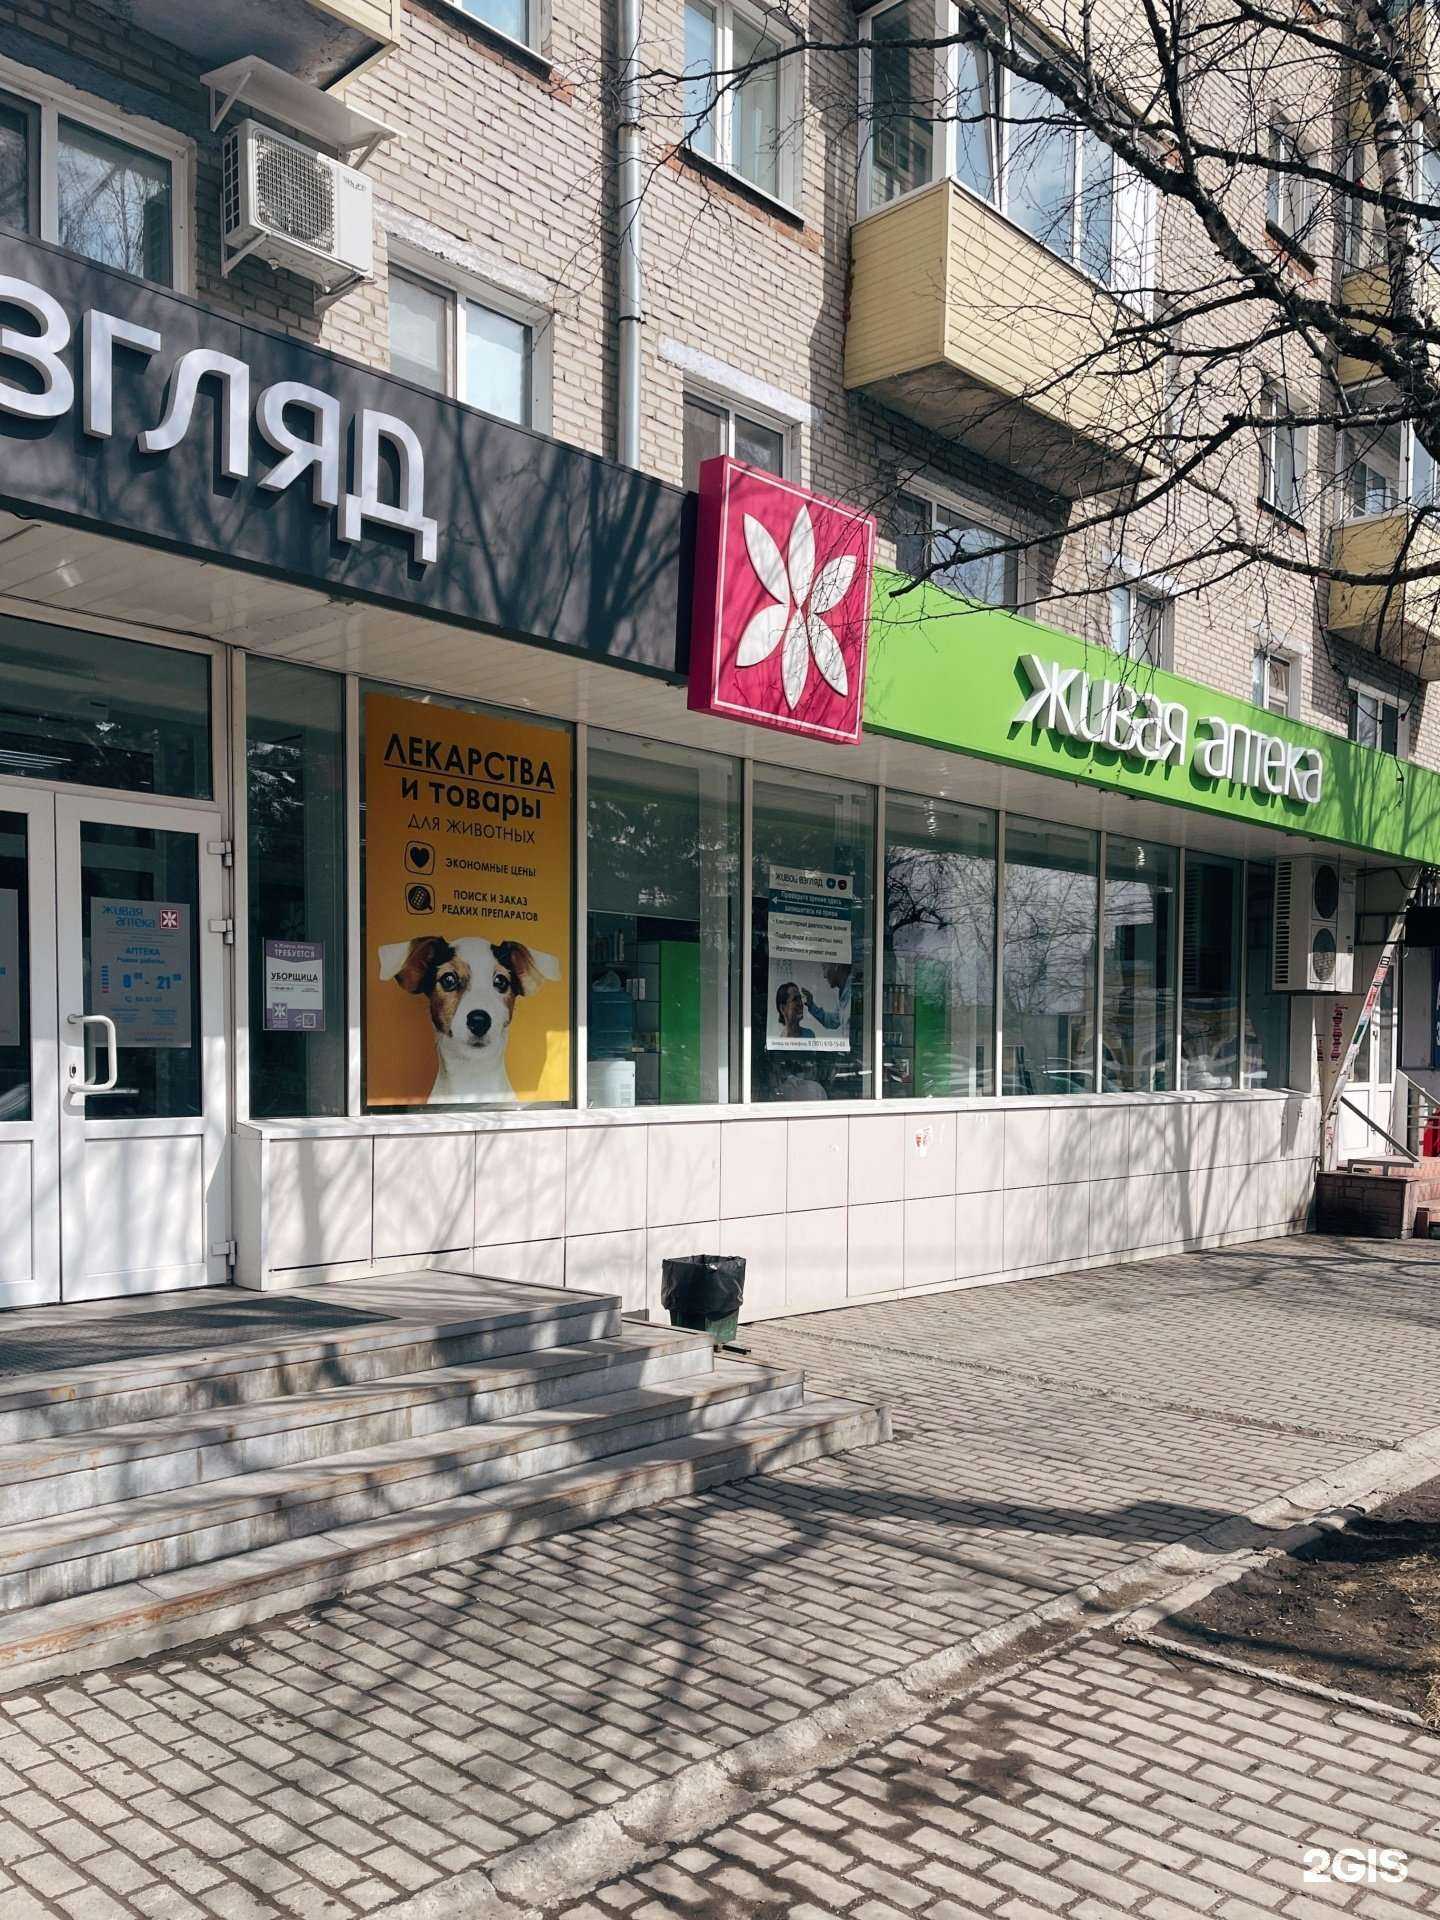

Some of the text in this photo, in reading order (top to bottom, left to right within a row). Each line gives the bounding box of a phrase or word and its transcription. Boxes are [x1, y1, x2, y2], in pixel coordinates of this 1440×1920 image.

[384, 733, 555, 789] ЛЕКАРСТВА
[1195, 716, 1323, 804] аптека
[429, 782, 541, 821] товары
[408, 814, 535, 844] ДЛЯ ЖИВОТНЫХ
[445, 857, 536, 877] ЭКОНОМНЫЕ ЦЕНЫ
[453, 889, 528, 906] ПОИСК И ЗАКАЗ
[442, 903, 538, 922] РЕДКИХ ПРЕПАРАТОВ
[126, 947, 160, 957] АПТЕКА
[274, 948, 315, 959] ТРЕБУЕТСЯ
[271, 972, 318, 983] УБОРЩИЦА
